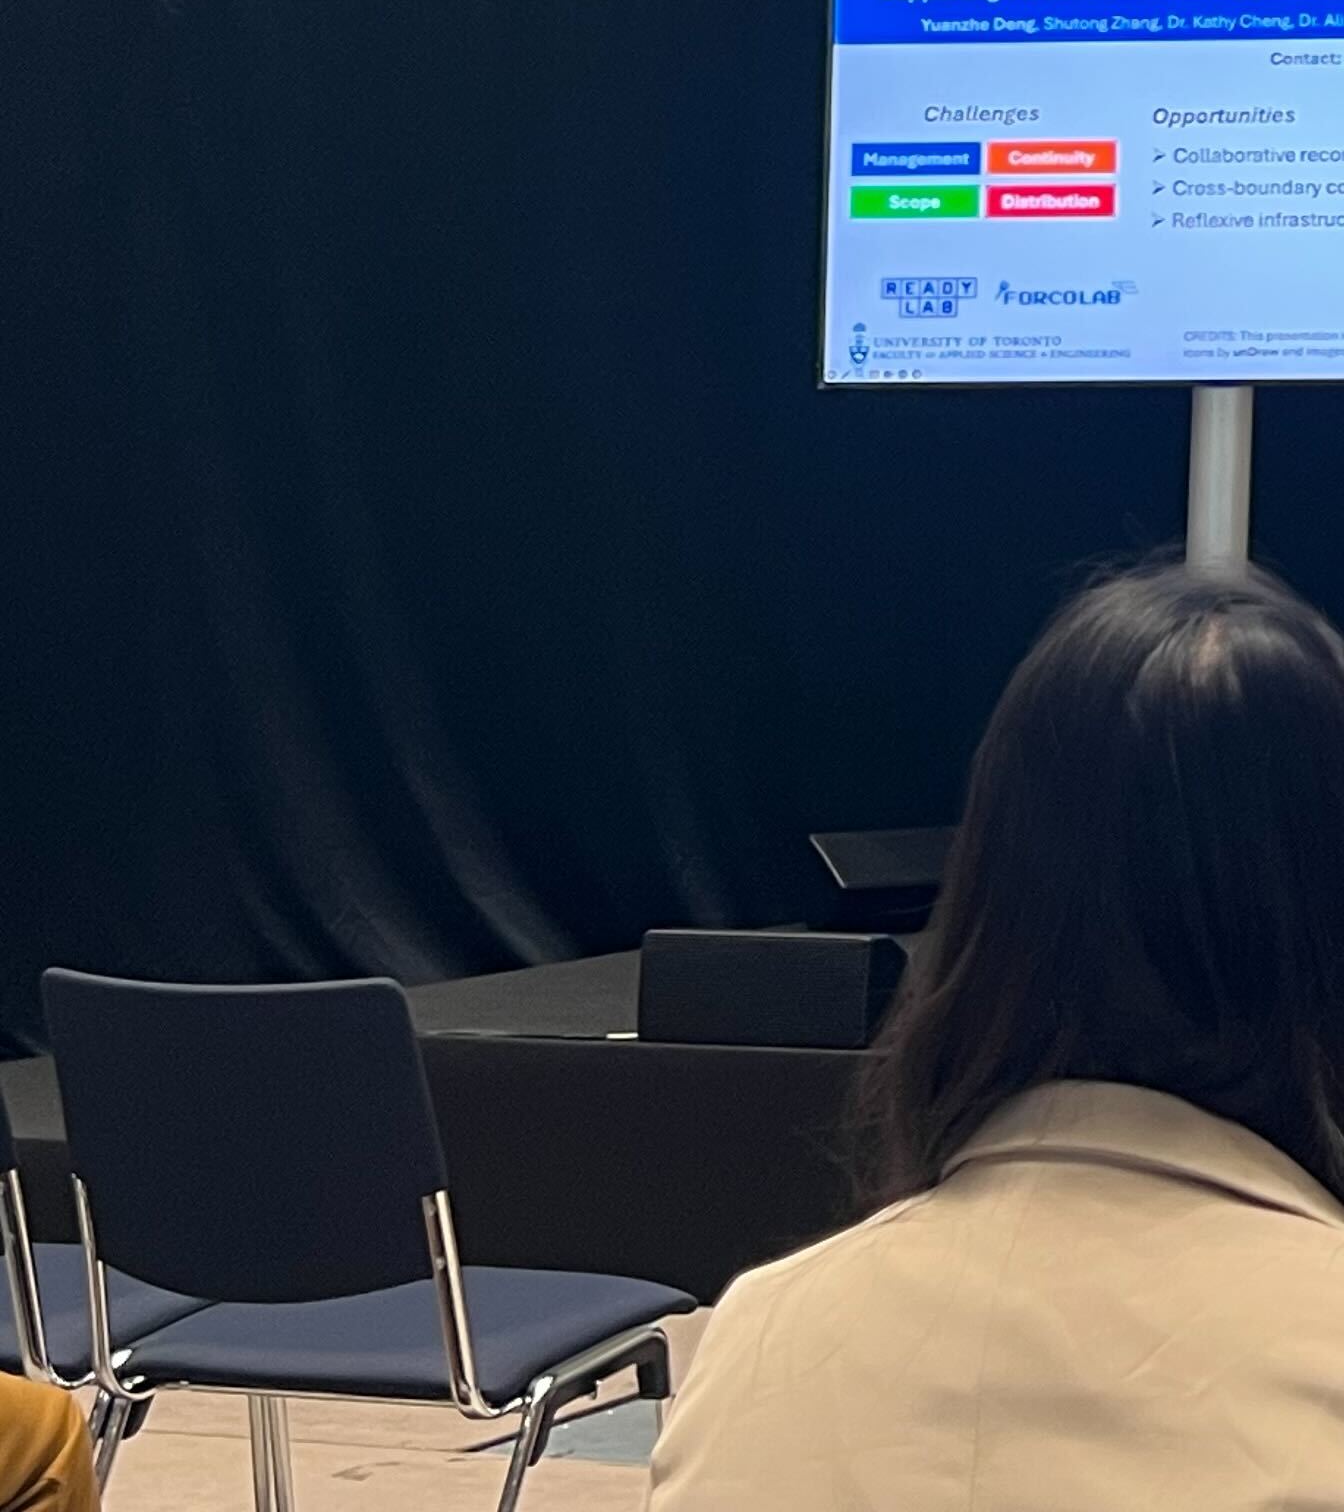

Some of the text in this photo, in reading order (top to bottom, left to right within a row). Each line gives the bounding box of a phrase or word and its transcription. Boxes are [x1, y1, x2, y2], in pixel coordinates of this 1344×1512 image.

[921, 18, 989, 31] Yuanzhe
[994, 17, 1039, 34] Deng,
[1043, 16, 1106, 32] Shutong
[1111, 15, 1162, 32] Zhang,
[1193, 15, 1235, 31] Kathy
[1240, 14, 1295, 31] Cheng,
[1270, 51, 1342, 66] Contact:
[924, 105, 1040, 125] Challenges
[1152, 106, 1296, 129] Opportunities
[863, 152, 969, 169] Management
[1008, 150, 1096, 168] Continuity
[1173, 147, 1296, 164] Collaborative
[1172, 180, 1322, 199] Cross-boundary
[889, 195, 941, 212] Scope
[1001, 193, 1100, 210] Distribution
[1172, 212, 1254, 229] Reflexive
[885, 281, 972, 296] READY
[1003, 289, 1121, 306] FORCOLAB
[905, 300, 953, 314] LAB
[873, 335, 1062, 348] UNIVERSITY OF TORONTO
